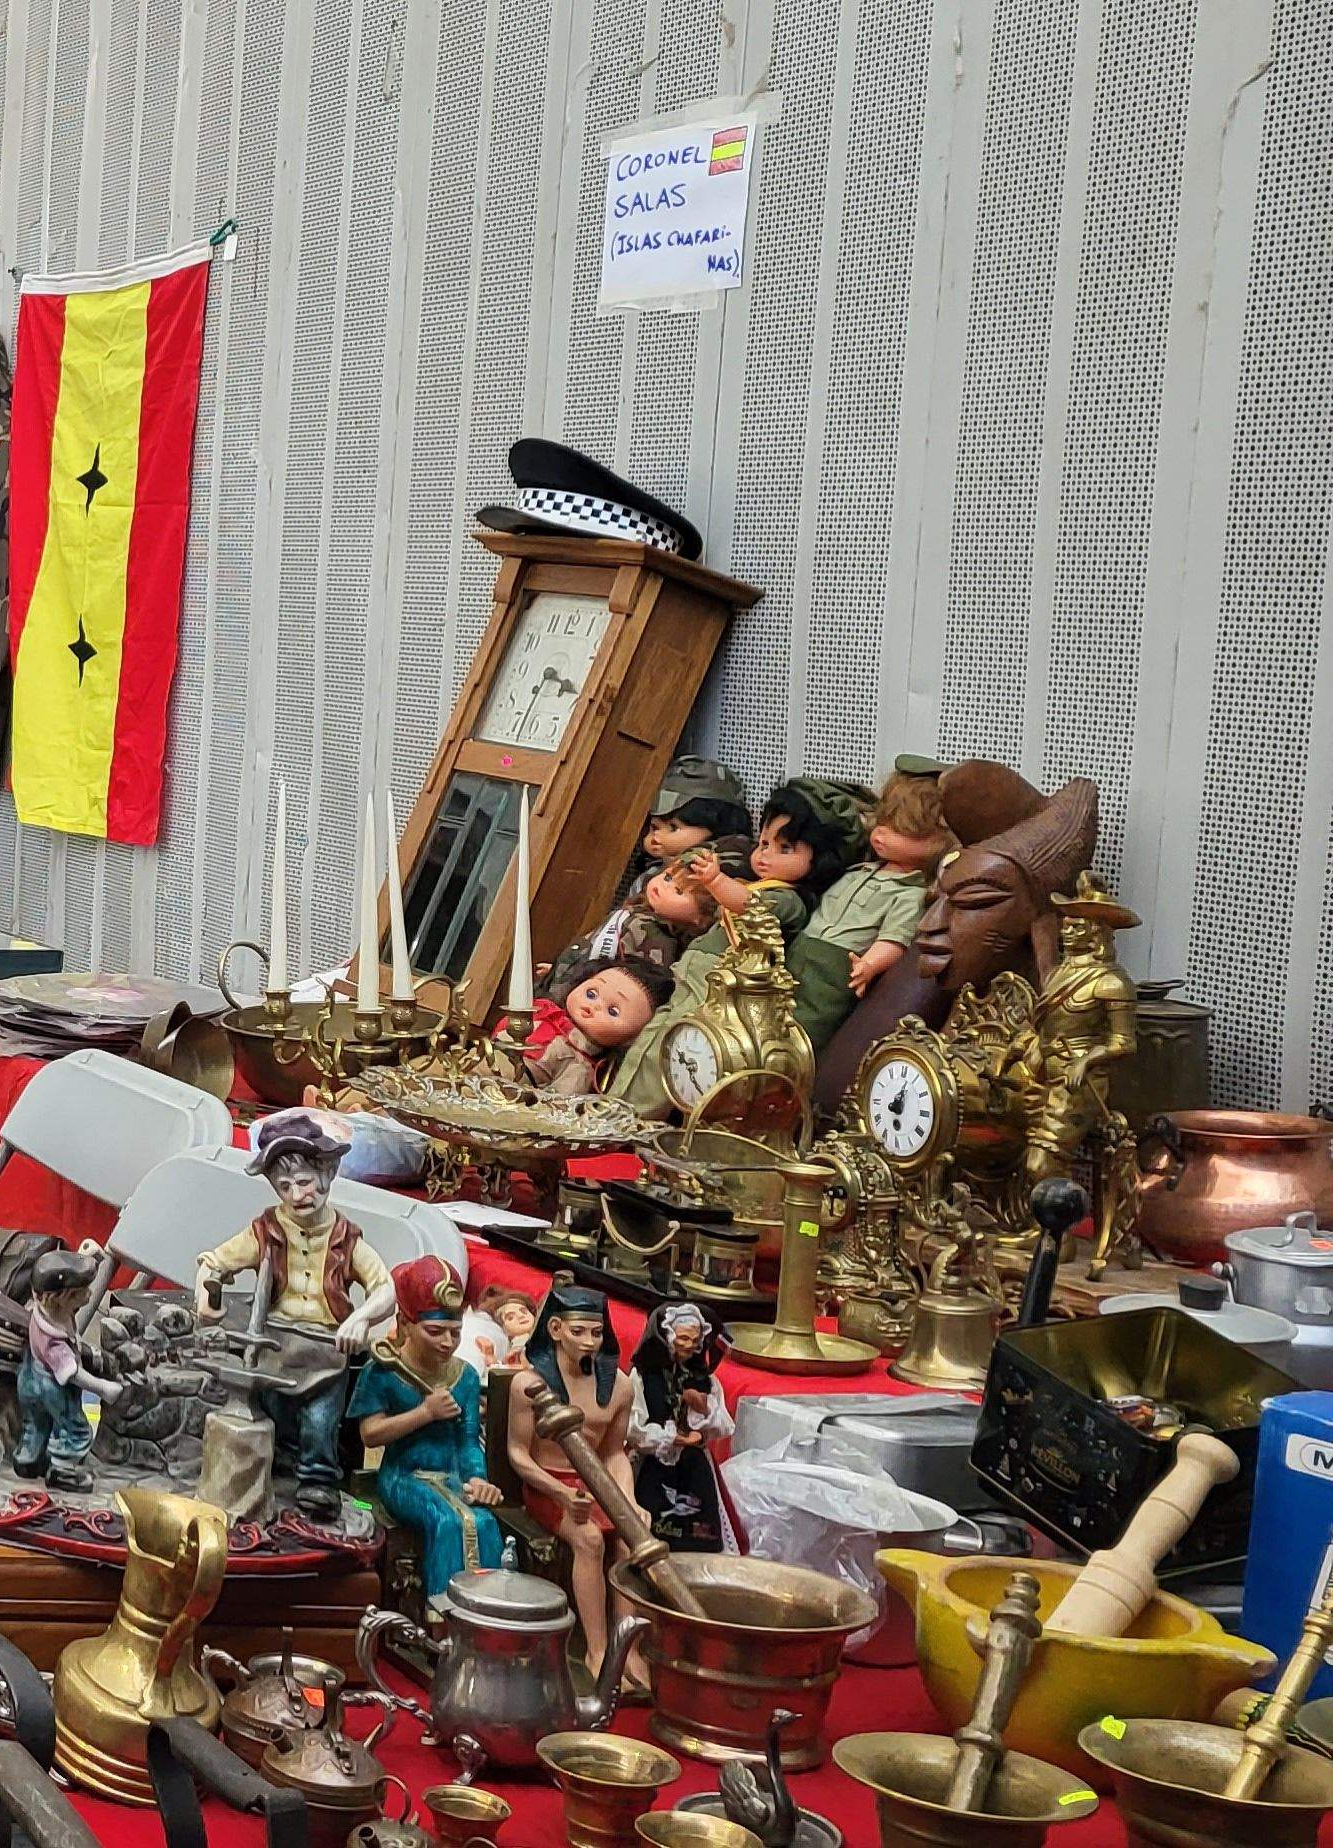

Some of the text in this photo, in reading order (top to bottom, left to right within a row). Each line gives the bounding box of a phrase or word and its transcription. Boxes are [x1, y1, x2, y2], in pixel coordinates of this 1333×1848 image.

[616, 146, 707, 182] CORONEL
[614, 184, 687, 219] SALAS
[611, 230, 663, 261] (ISLAS
[517, 660, 529, 679] 9
[528, 713, 540, 735] 6
